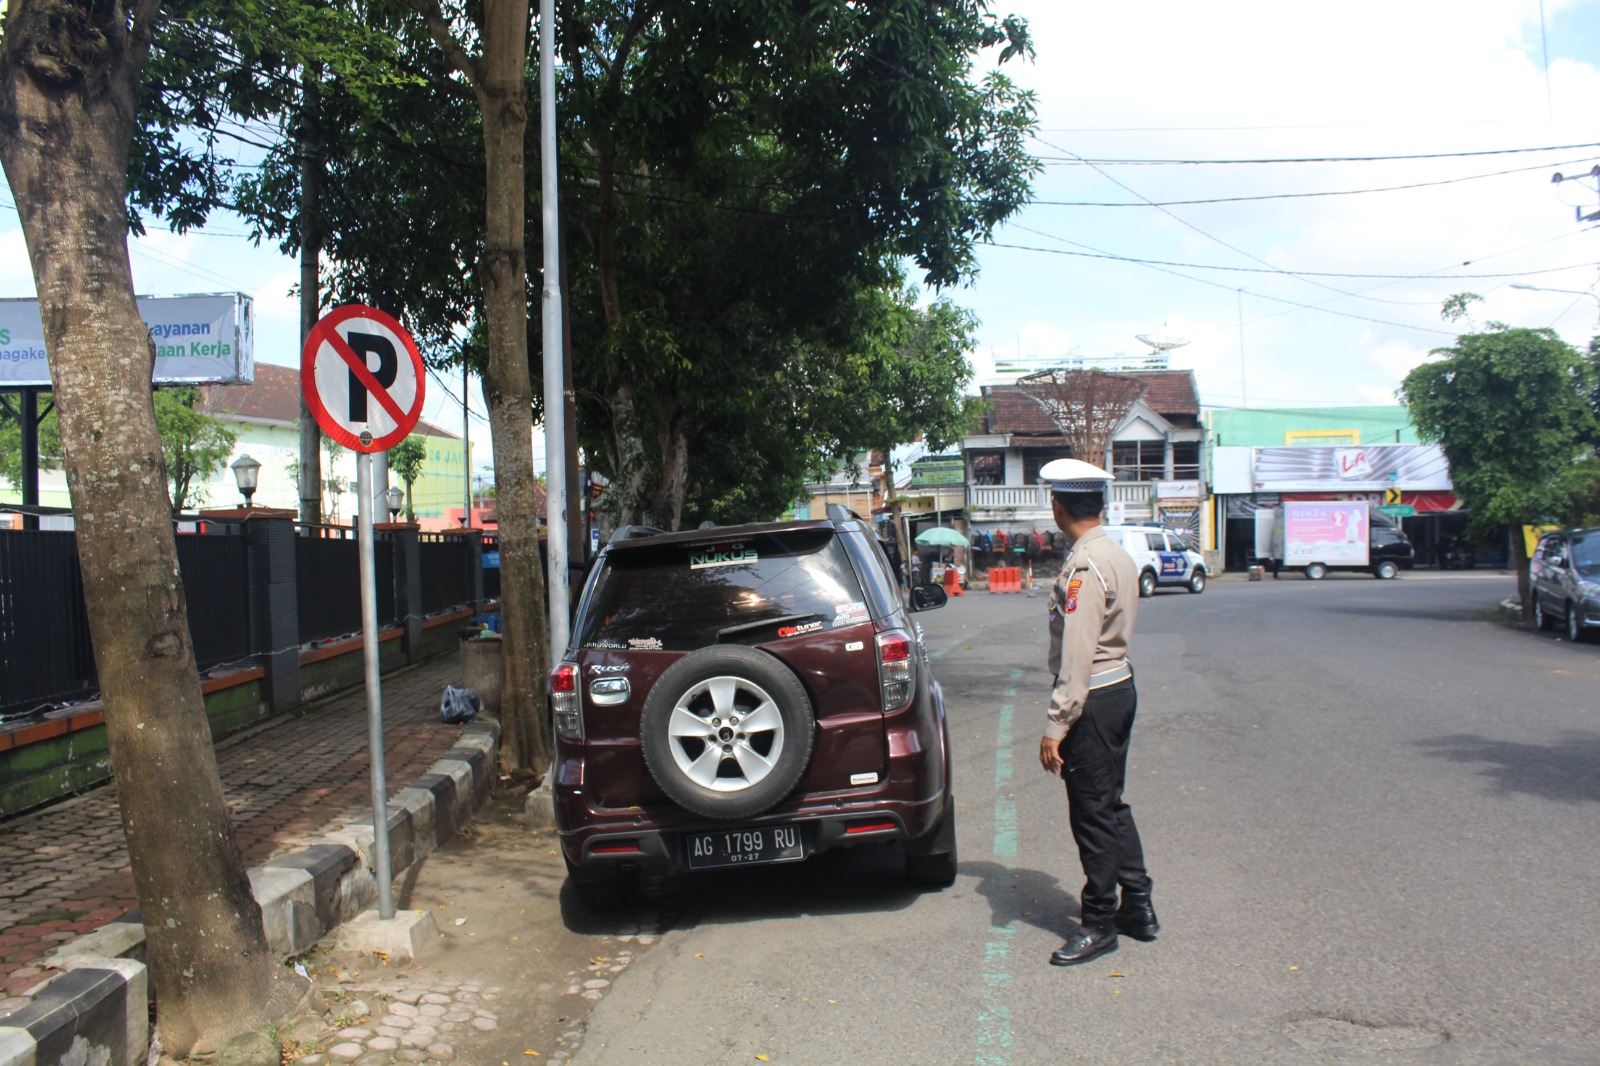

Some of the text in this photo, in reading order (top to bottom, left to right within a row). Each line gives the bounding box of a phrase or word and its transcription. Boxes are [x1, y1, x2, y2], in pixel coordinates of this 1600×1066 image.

[157, 341, 231, 359] aan Kerja
[347, 331, 398, 423] P
[690, 549, 759, 565] NUKUS
[694, 827, 796, 857] AG 1799 RU
